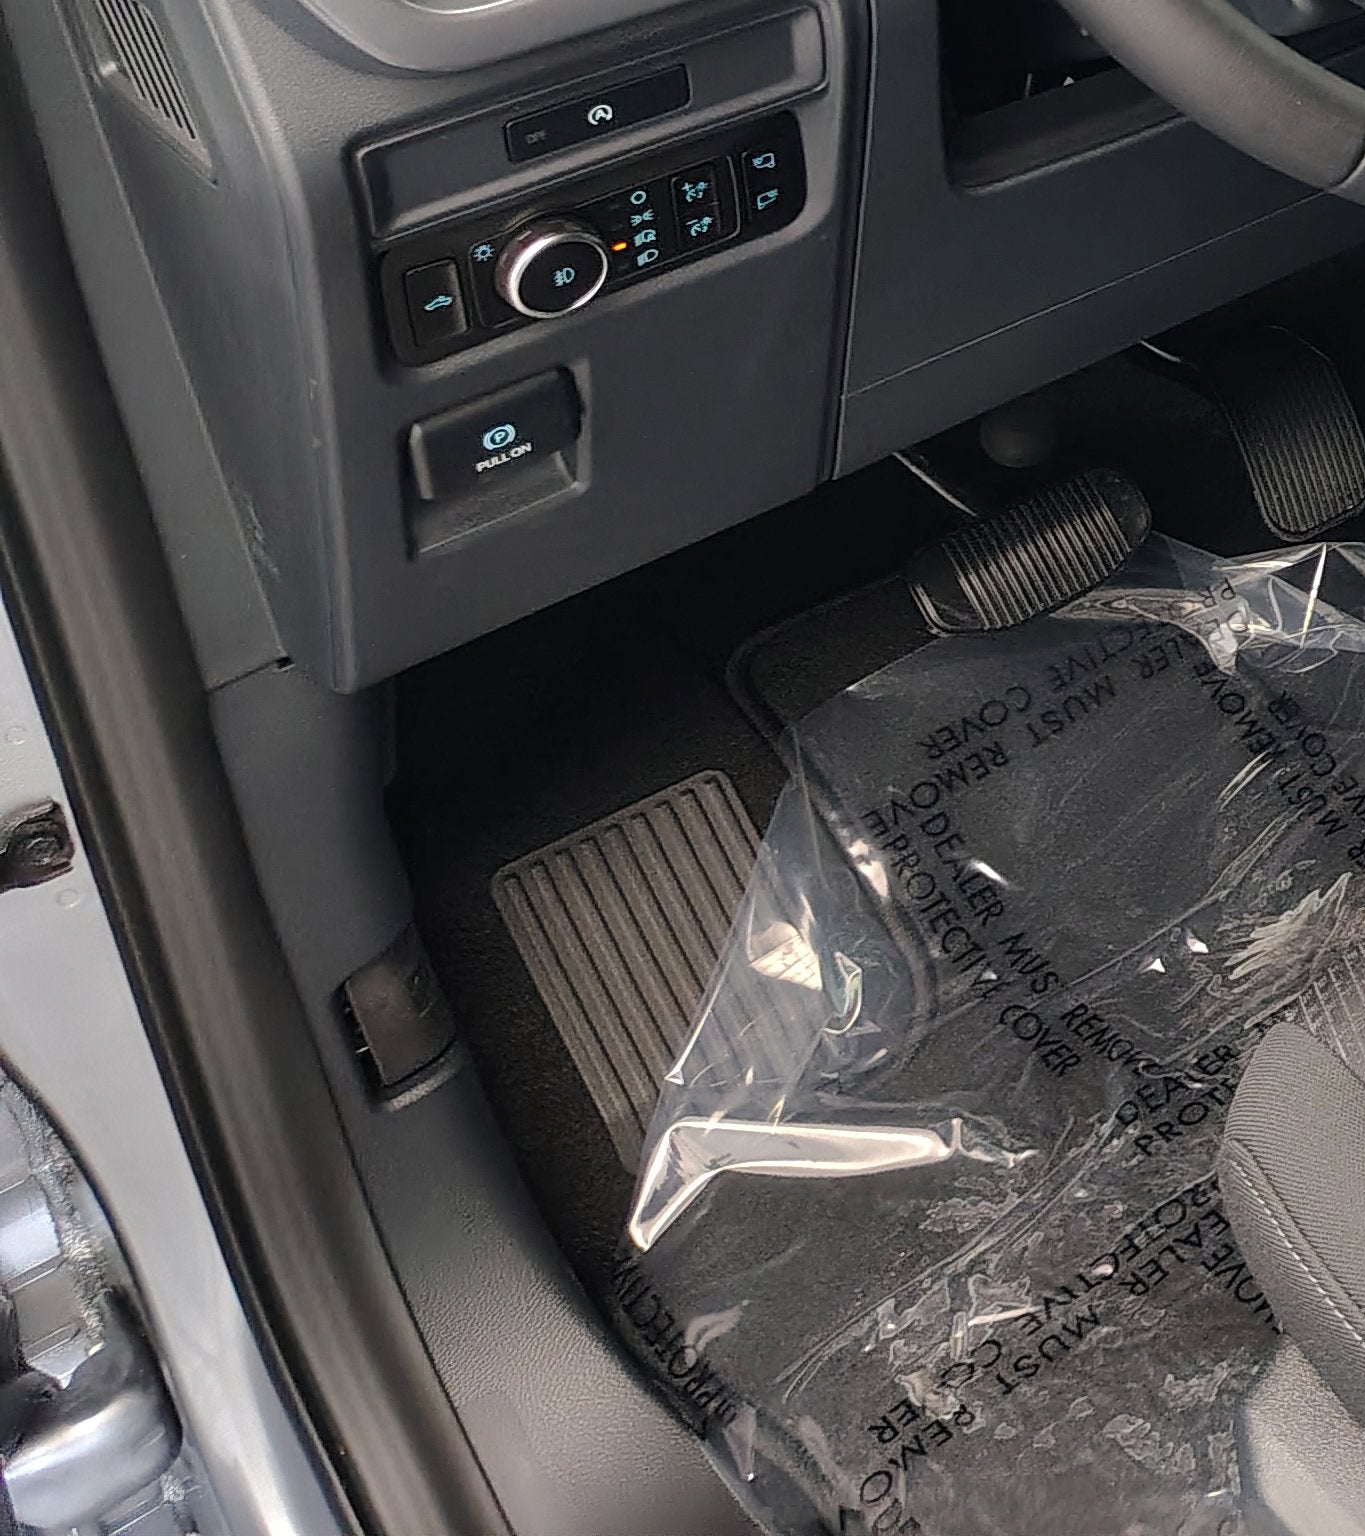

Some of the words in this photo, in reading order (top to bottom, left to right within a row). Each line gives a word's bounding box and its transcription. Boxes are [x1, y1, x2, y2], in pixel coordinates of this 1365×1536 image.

[475, 453, 511, 472] PULL
[510, 442, 532, 457] ON
[919, 684, 1032, 760] COVER
[1025, 675, 1117, 748] MUST
[861, 741, 1010, 838] REMOVE
[1000, 932, 1062, 994] MUS
[1000, 1004, 1081, 1077] COVER
[1119, 1209, 1231, 1296] EALER
[995, 1305, 1100, 1395] MUST
